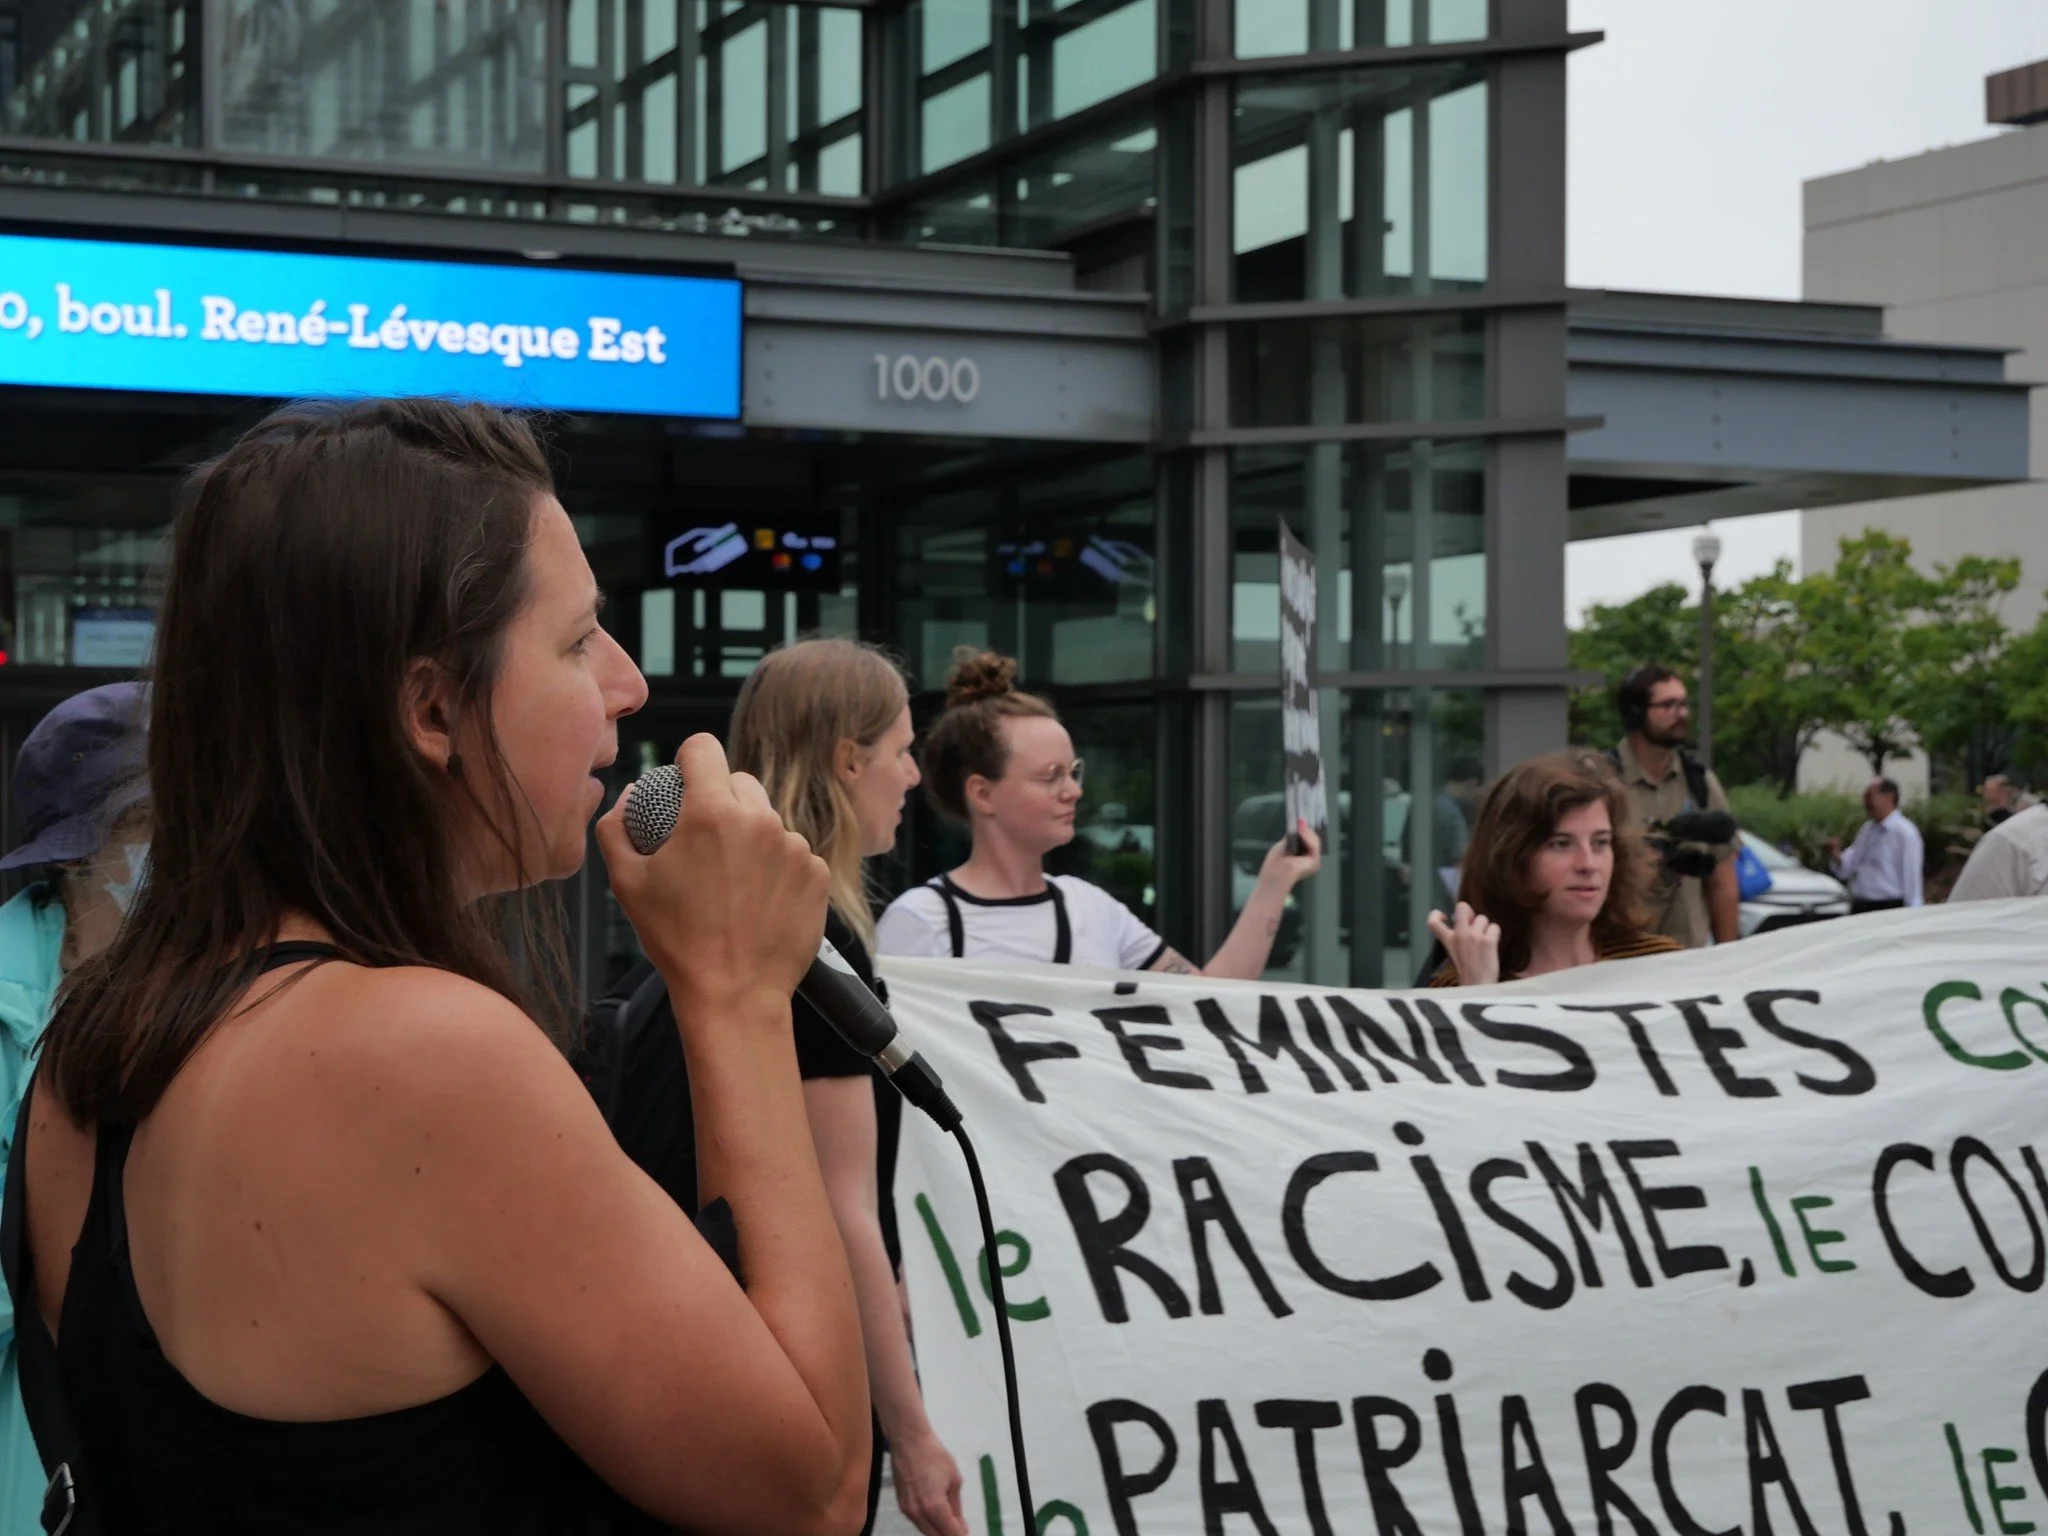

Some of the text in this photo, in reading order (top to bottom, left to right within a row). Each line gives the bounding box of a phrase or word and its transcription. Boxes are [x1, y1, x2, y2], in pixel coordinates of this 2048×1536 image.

[55, 282, 188, 339] boul.
[200, 295, 580, 368] René-Lévesque
[588, 317, 667, 365] Est
[874, 354, 981, 402] 1000
[968, 982, 1878, 1104] FÉMINISTES
[914, 1192, 1052, 1339] le
